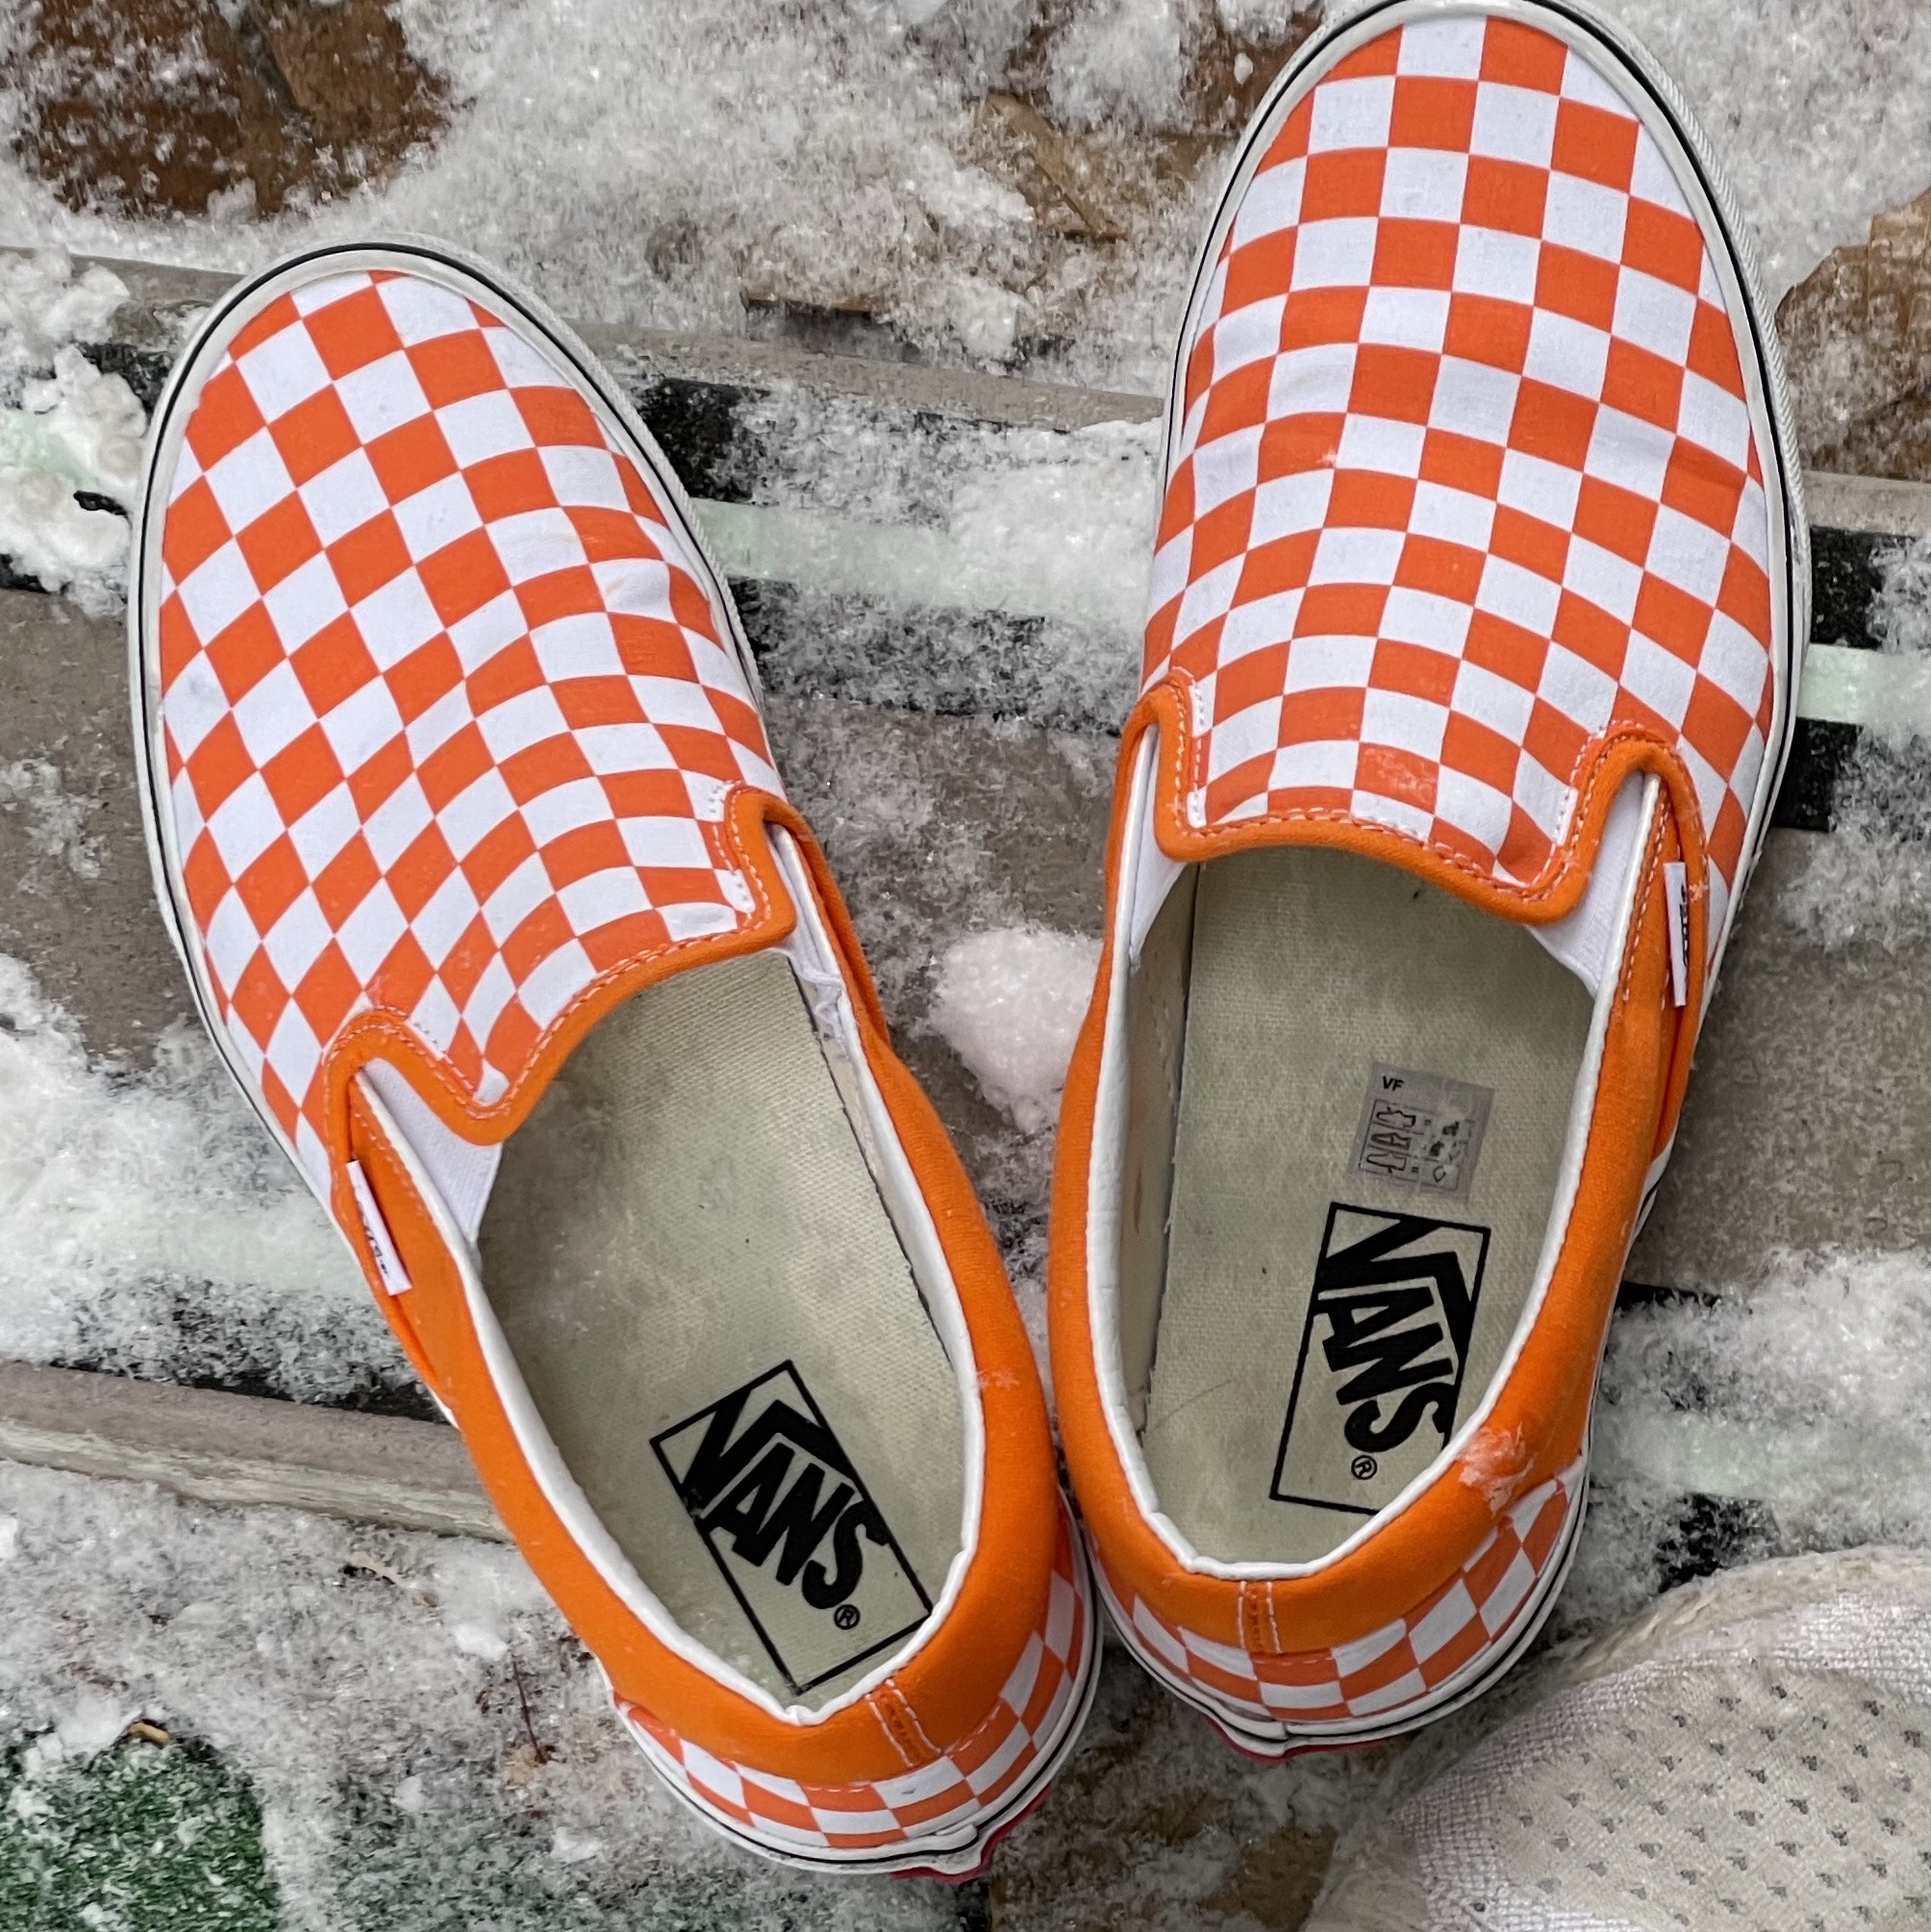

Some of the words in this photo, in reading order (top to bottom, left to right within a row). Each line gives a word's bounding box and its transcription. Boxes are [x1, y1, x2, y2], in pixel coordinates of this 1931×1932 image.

[1382, 1075, 1405, 1091] VF
[1312, 1216, 1473, 1452] VANS
[681, 1388, 890, 1609] VANS
